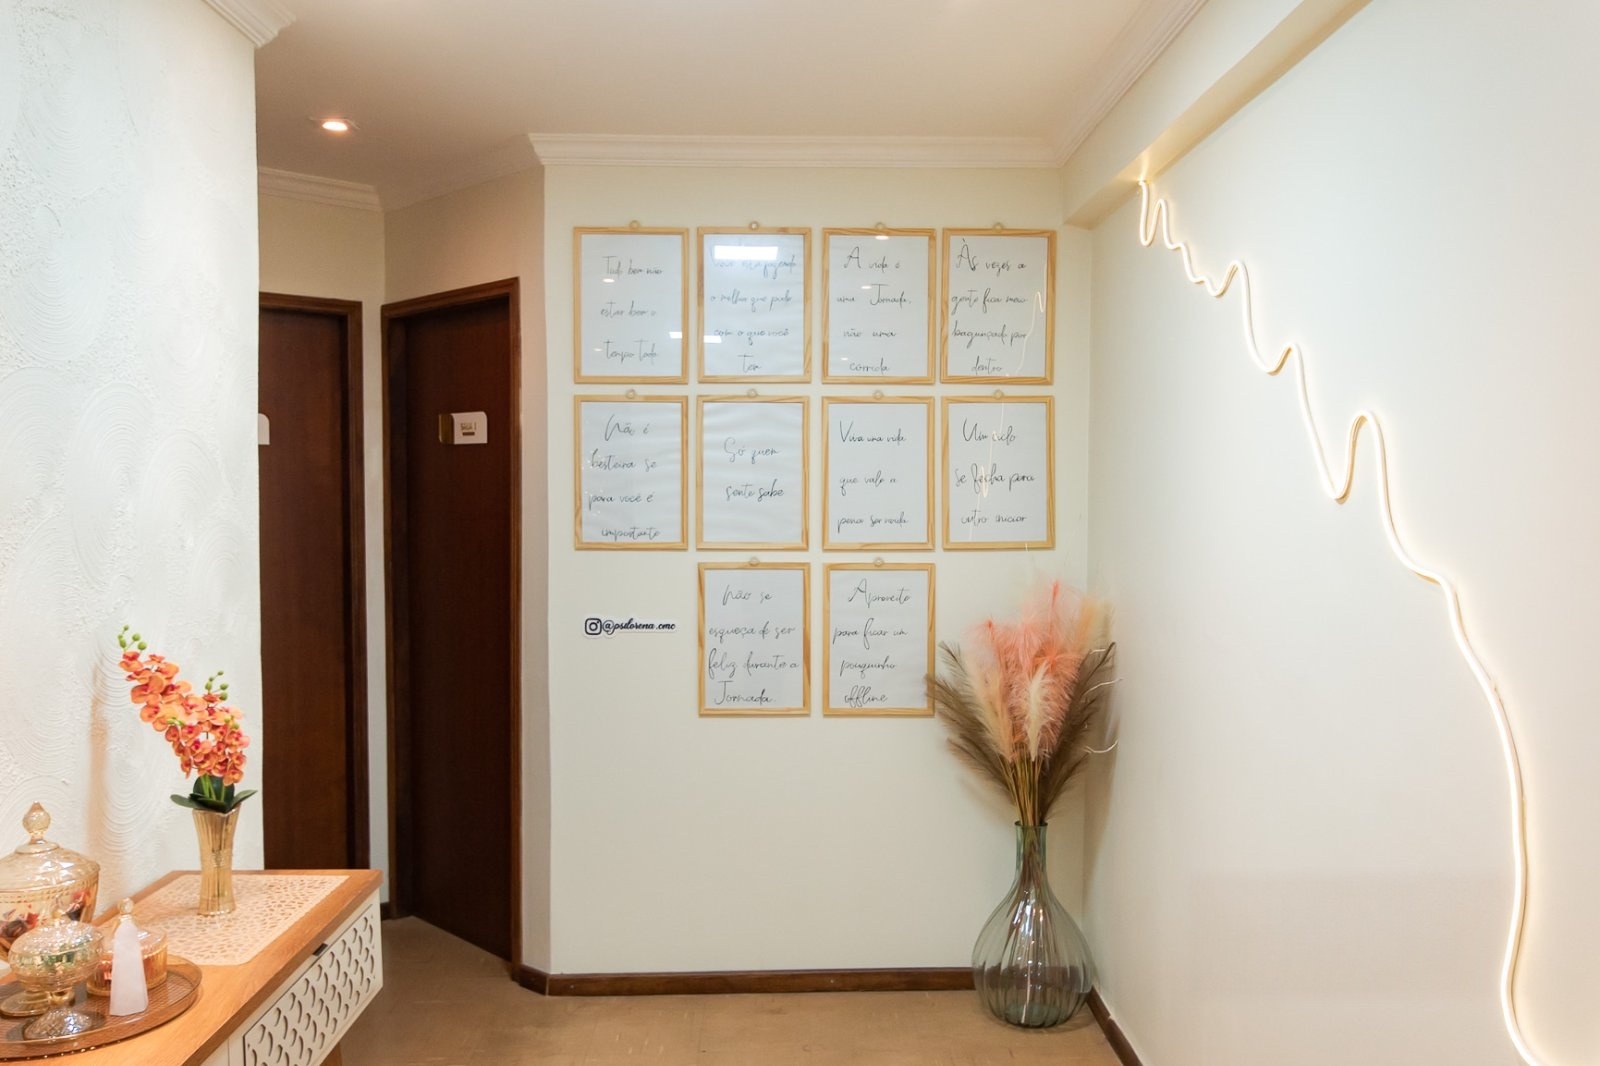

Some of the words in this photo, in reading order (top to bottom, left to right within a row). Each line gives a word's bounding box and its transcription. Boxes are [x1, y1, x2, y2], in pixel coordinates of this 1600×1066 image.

[844, 246, 861, 269] A
[869, 256, 889, 273] vida
[956, 238, 978, 272] Às
[985, 260, 1011, 276] vezes
[951, 289, 979, 315] gente
[843, 328, 862, 337] não
[972, 355, 1003, 375] dentro
[605, 414, 635, 441] Não
[840, 419, 864, 442] Viva
[887, 428, 907, 446] vida
[962, 417, 988, 442] Um
[591, 448, 636, 471] besteira
[645, 459, 657, 472] se
[751, 447, 781, 465] quem
[725, 483, 755, 503] sente
[757, 478, 784, 503] sabe
[840, 477, 858, 496] que
[865, 470, 885, 487] vale
[589, 494, 615, 511] para
[620, 495, 641, 503] você
[837, 518, 863, 533] pena
[760, 592, 773, 603] se
[709, 626, 756, 644] esqueça
[775, 628, 796, 639] ser
[833, 626, 859, 644] para
[864, 617, 888, 650] ficar
[709, 647, 737, 679] feliz
[845, 685, 888, 708] offline
